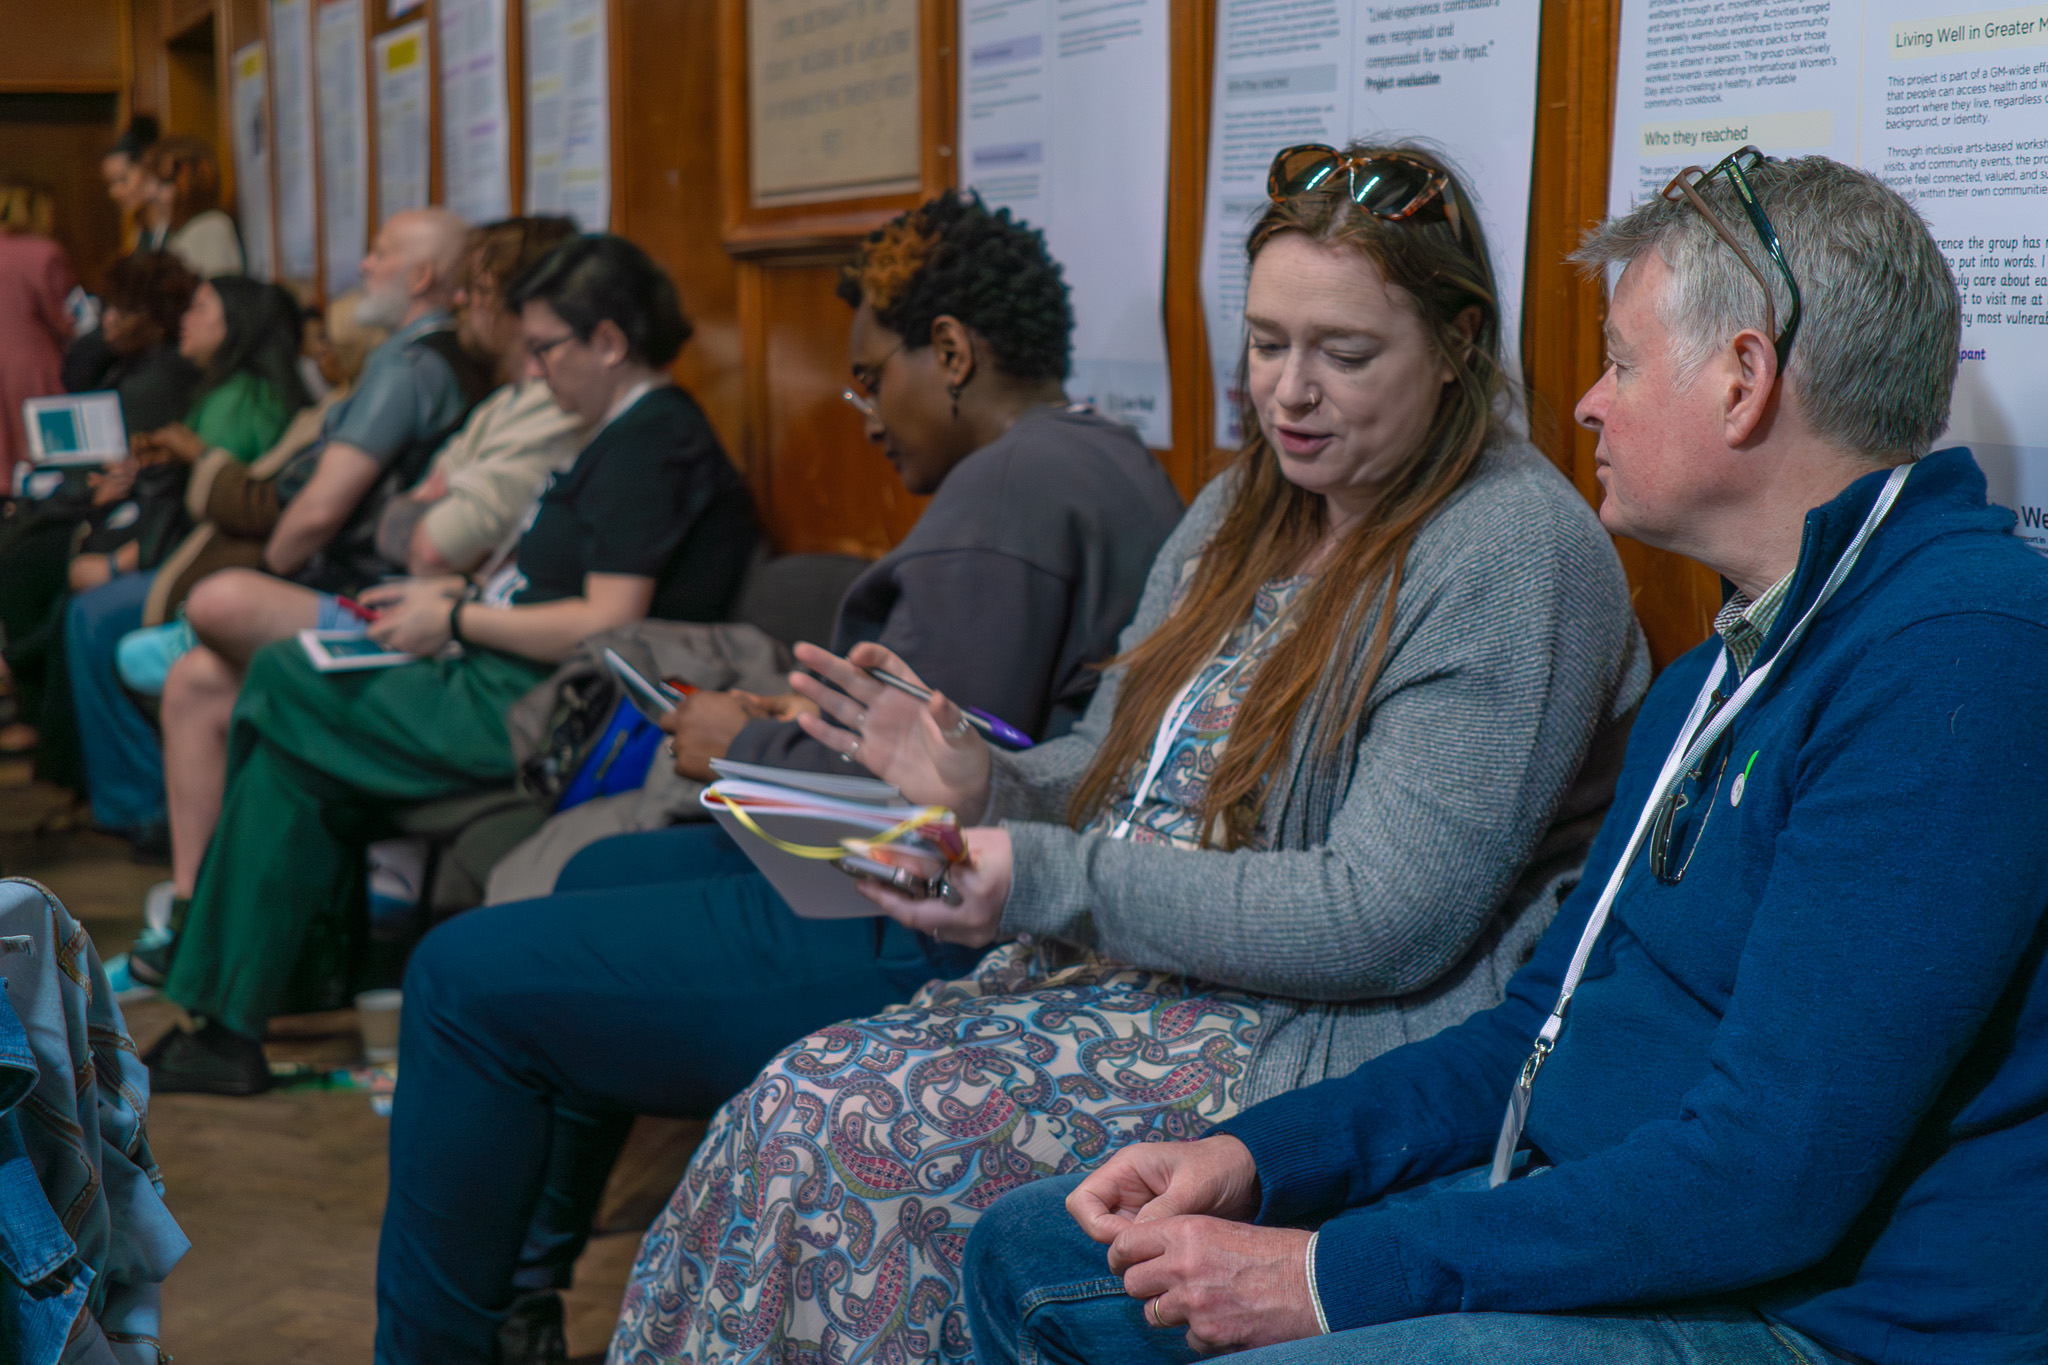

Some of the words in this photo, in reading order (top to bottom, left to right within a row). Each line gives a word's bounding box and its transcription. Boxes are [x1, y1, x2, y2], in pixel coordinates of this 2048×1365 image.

[1662, 20, 1685, 31] shared
[1687, 17, 1714, 28] cultural
[1763, 7, 1799, 18] Activities
[1801, 1, 1830, 15] ranged
[1682, 4, 1711, 16] through
[1665, 33, 1689, 43] weekly
[1691, 28, 1728, 40] warm-hub
[1731, 24, 1771, 35] workshops
[1773, 22, 1782, 31] to
[1784, 16, 1829, 29] community
[1896, 31, 1933, 48] Living
[1937, 25, 1965, 43] Well
[1969, 25, 1981, 40] in
[1984, 20, 2035, 38] Greater
[1438, 46, 1460, 61] their
[1646, 48, 1669, 58] events
[1670, 46, 1684, 55] and
[1686, 41, 1731, 53] home-based
[1733, 39, 1764, 49] creative
[1766, 35, 1789, 46] packs
[1791, 31, 1802, 42] for
[1804, 31, 1826, 41] those
[1680, 57, 1703, 68] attend
[1744, 50, 1758, 61] The
[1760, 50, 1784, 62] group
[1786, 43, 1831, 57] collectively
[1646, 73, 1671, 83] worked
[1672, 70, 1702, 81] towards
[1704, 67, 1747, 79] celebrating
[1749, 61, 1796, 73] International
[1799, 56, 1838, 69] Women's
[1888, 76, 1905, 87] This
[1907, 73, 1938, 86] project
[1940, 72, 1947, 83] is
[1950, 70, 1968, 83] part
[1970, 68, 1982, 80] of
[1982, 70, 1989, 79] a
[1990, 66, 2031, 79] GM-wide
[1366, 76, 1394, 94] Project
[1396, 71, 1441, 88] evaluation
[1644, 86, 1658, 97] Day
[1659, 85, 1673, 95] and
[1756, 74, 1797, 86] affordable
[1887, 90, 1904, 101] that
[1906, 88, 1937, 100] people
[1939, 86, 1955, 97] can
[1956, 84, 1987, 95] access
[1989, 80, 2018, 94] health
[2020, 78, 2038, 91] and
[1644, 97, 1683, 109] community
[1886, 103, 1920, 115] support
[1923, 101, 1949, 112] where
[1951, 100, 1971, 112] they
[1973, 98, 1992, 109] live,
[1994, 94, 2042, 109] regardless
[1886, 115, 1939, 130] background,
[1942, 116, 1951, 126] or
[1953, 113, 1990, 126] identity.
[1645, 131, 1670, 146] Who
[1673, 130, 1698, 147] they
[1701, 125, 1748, 143] reached
[1888, 146, 1923, 158] Through
[1925, 144, 1963, 156] inclusive
[1966, 140, 2013, 154] arts-based
[1909, 160, 1926, 171] and
[1929, 157, 1979, 171] community
[1981, 156, 2014, 167] events,
[2016, 154, 2031, 166] the
[1883, 175, 1913, 187] people
[1915, 174, 1931, 185] feel
[1933, 171, 1982, 184] connected,
[1985, 170, 2018, 182] valued,
[2020, 169, 2038, 181] and
[1919, 187, 1946, 199] within
[1949, 186, 1969, 198] their
[1972, 188, 1990, 197] own
[1938, 239, 1964, 250] rence
[1969, 235, 1984, 249] the
[1989, 239, 2018, 253] group
[2023, 235, 2041, 249] has
[1959, 256, 1976, 271] put
[1981, 255, 2000, 268] into
[2004, 254, 2037, 268] words.
[1955, 272, 1969, 290] uly
[1974, 276, 1997, 286] care
[2001, 273, 2030, 287] about
[1972, 293, 1982, 304] to
[1986, 292, 2007, 305] visit
[2012, 295, 2027, 305] me
[2032, 294, 2043, 305] at
[1977, 312, 2002, 324] most
[1960, 348, 1986, 364] pant
